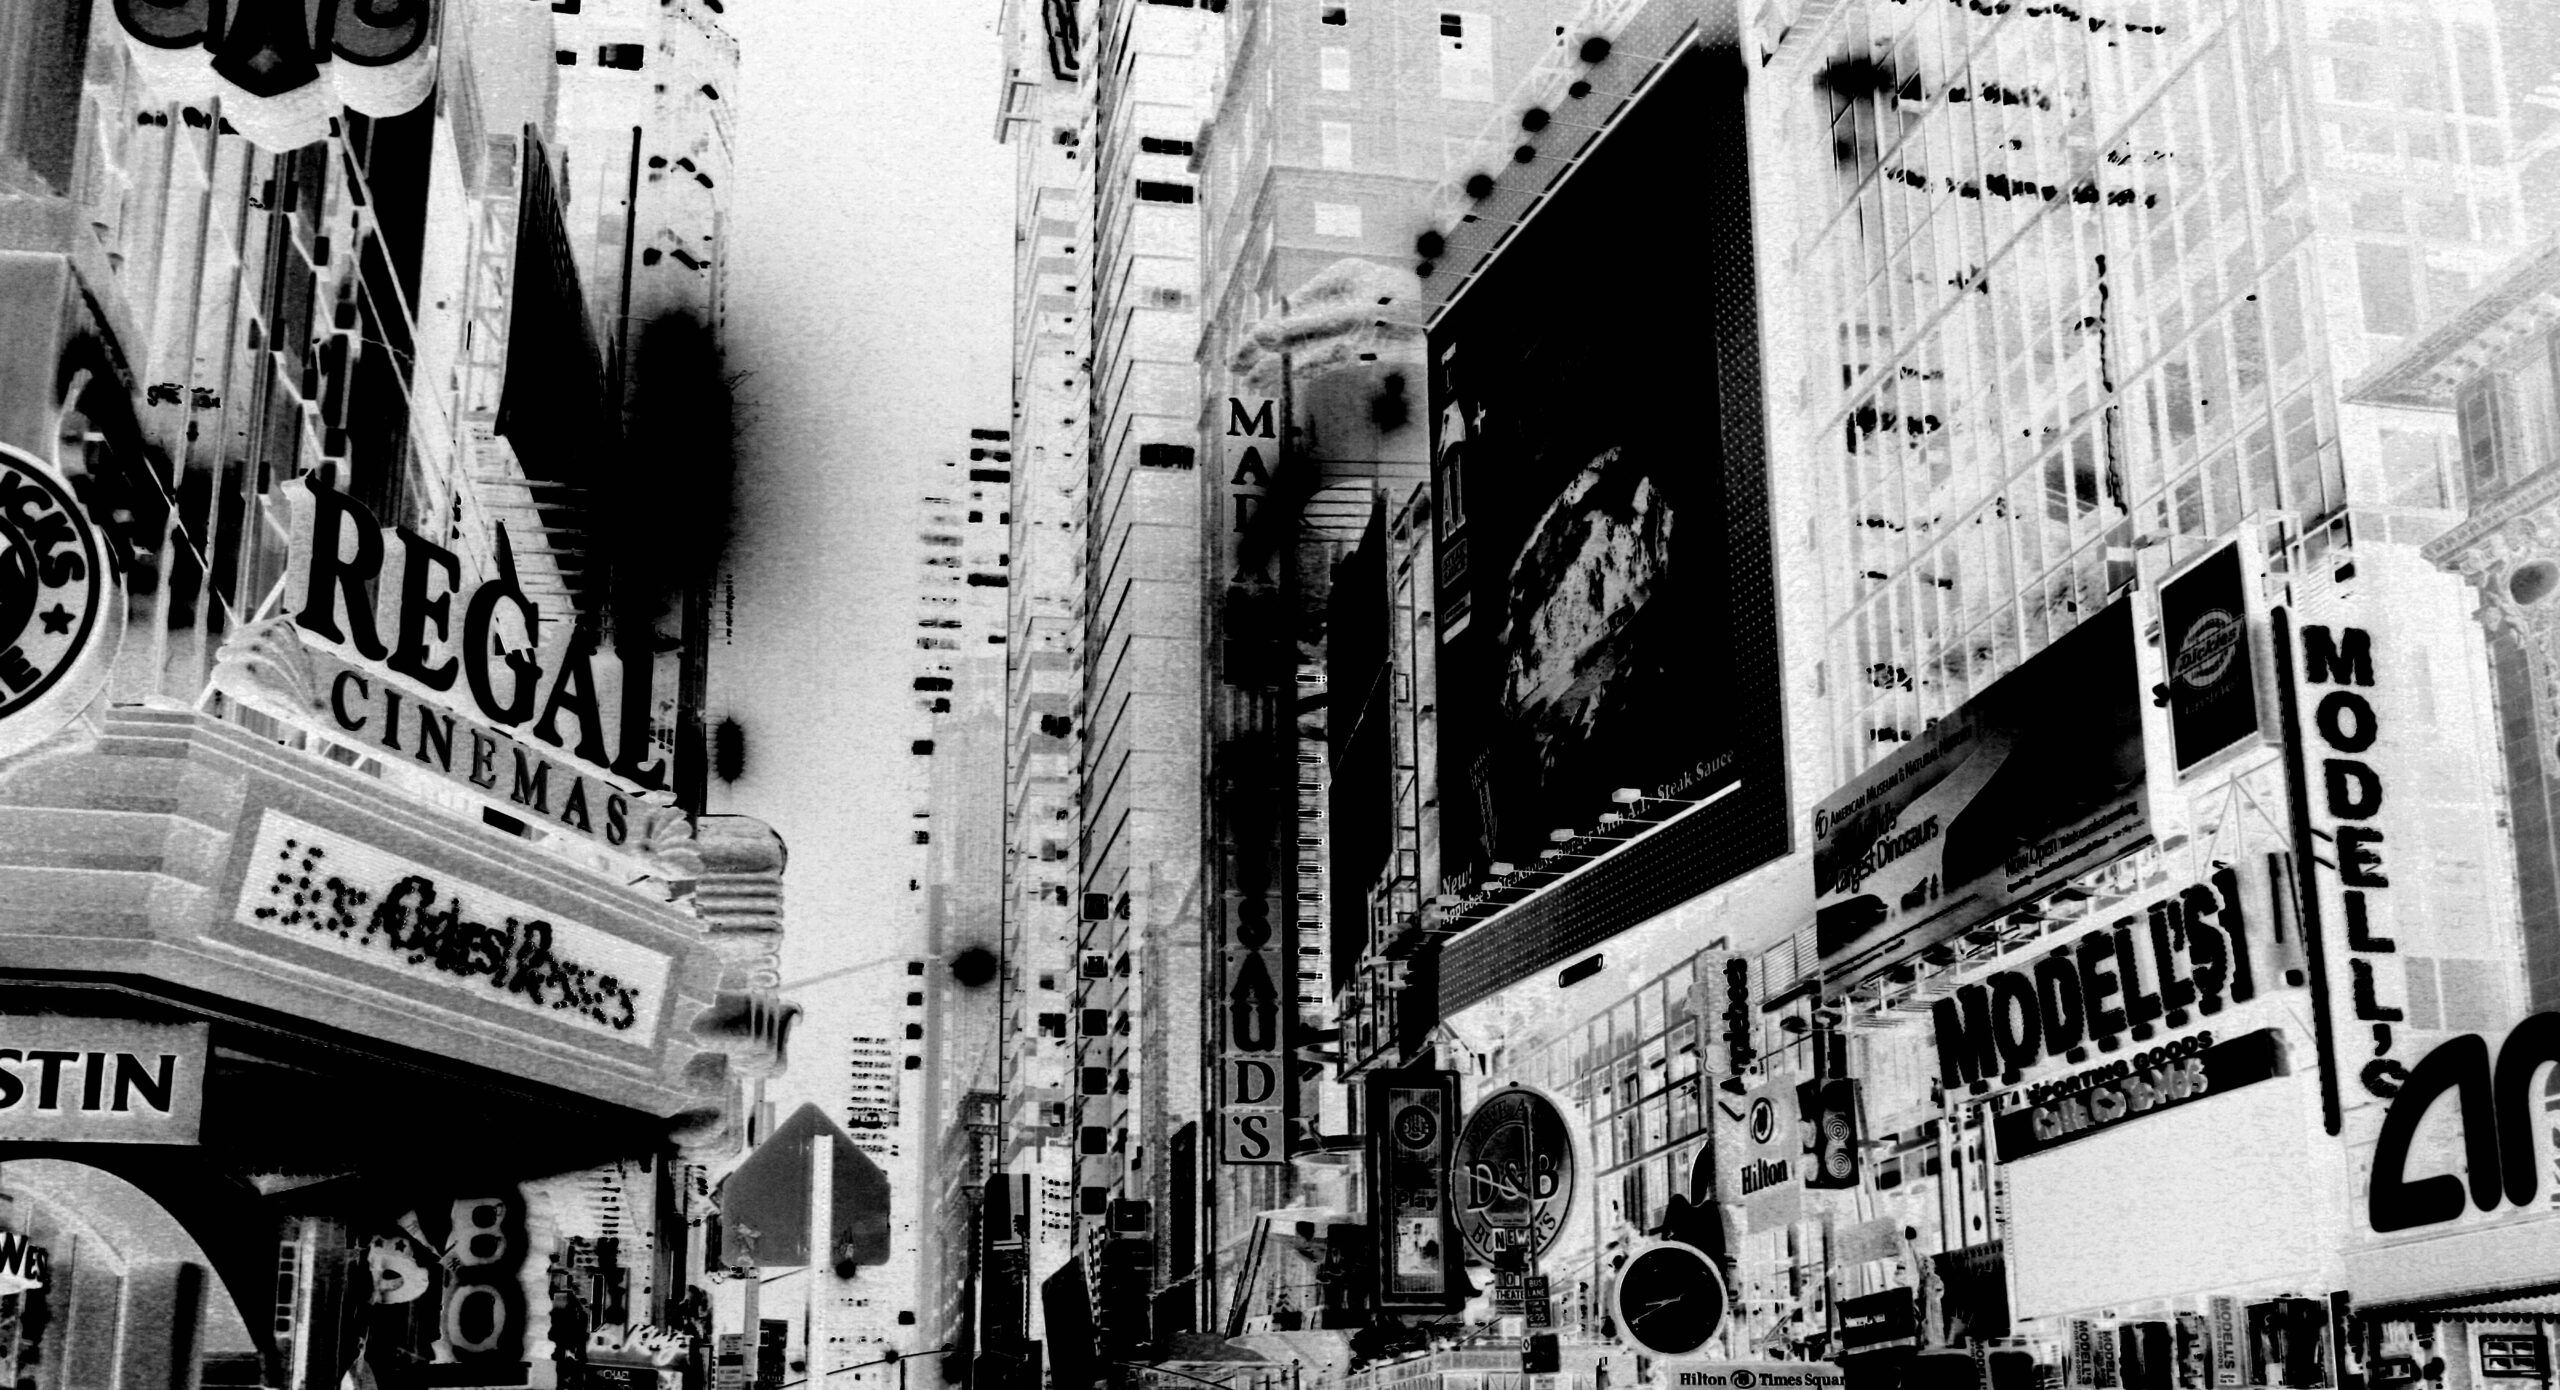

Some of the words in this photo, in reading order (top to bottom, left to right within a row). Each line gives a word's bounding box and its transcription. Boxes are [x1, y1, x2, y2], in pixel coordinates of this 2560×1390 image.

[296, 468, 670, 793] REGAL
[330, 670, 628, 846] CINEMAS
[1657, 771, 1693, 804] Steak
[1696, 750, 1735, 781] Sauce
[1877, 814, 1939, 869] Dinosaurs
[2027, 1060, 2129, 1107] SPORTING
[2133, 1030, 2214, 1071] GOODS
[1464, 1153, 1561, 1211] D&B
[1741, 1158, 1789, 1196] Hilton
[1494, 1229, 1528, 1250] NEW
[2078, 1320, 2093, 1386] MODELL'S
[2220, 1298, 2235, 1369] MODELL'S
[1680, 1372, 1727, 1386] Hilton
[1759, 1372, 1803, 1386] Times
